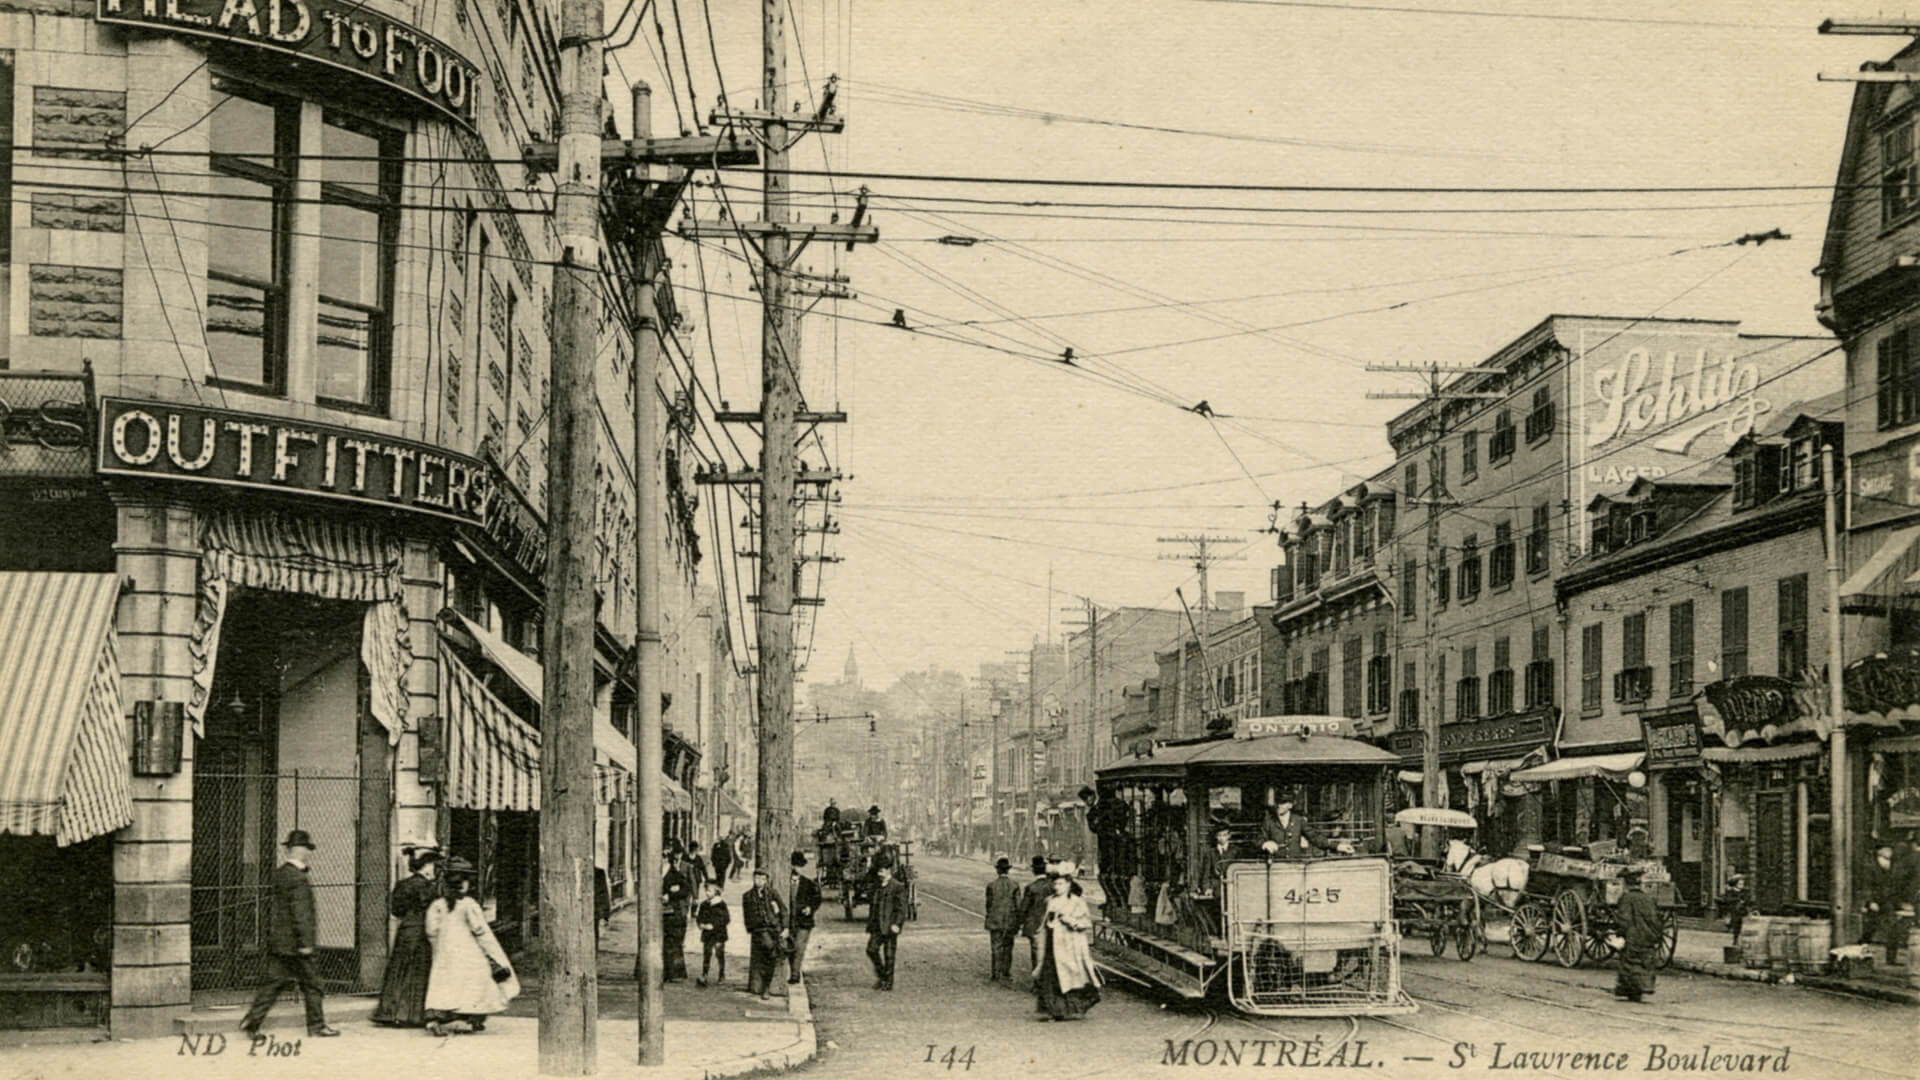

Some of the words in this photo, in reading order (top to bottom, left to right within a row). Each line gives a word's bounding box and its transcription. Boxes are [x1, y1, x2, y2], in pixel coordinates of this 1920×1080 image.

[107, 0, 311, 42] AD
[386, 25, 482, 119] FOOT
[1587, 347, 1772, 450] Schlitz
[112, 410, 486, 516] OUTFITTERS
[1249, 721, 1340, 734] ONTARIO
[1283, 887, 1342, 905] 425
